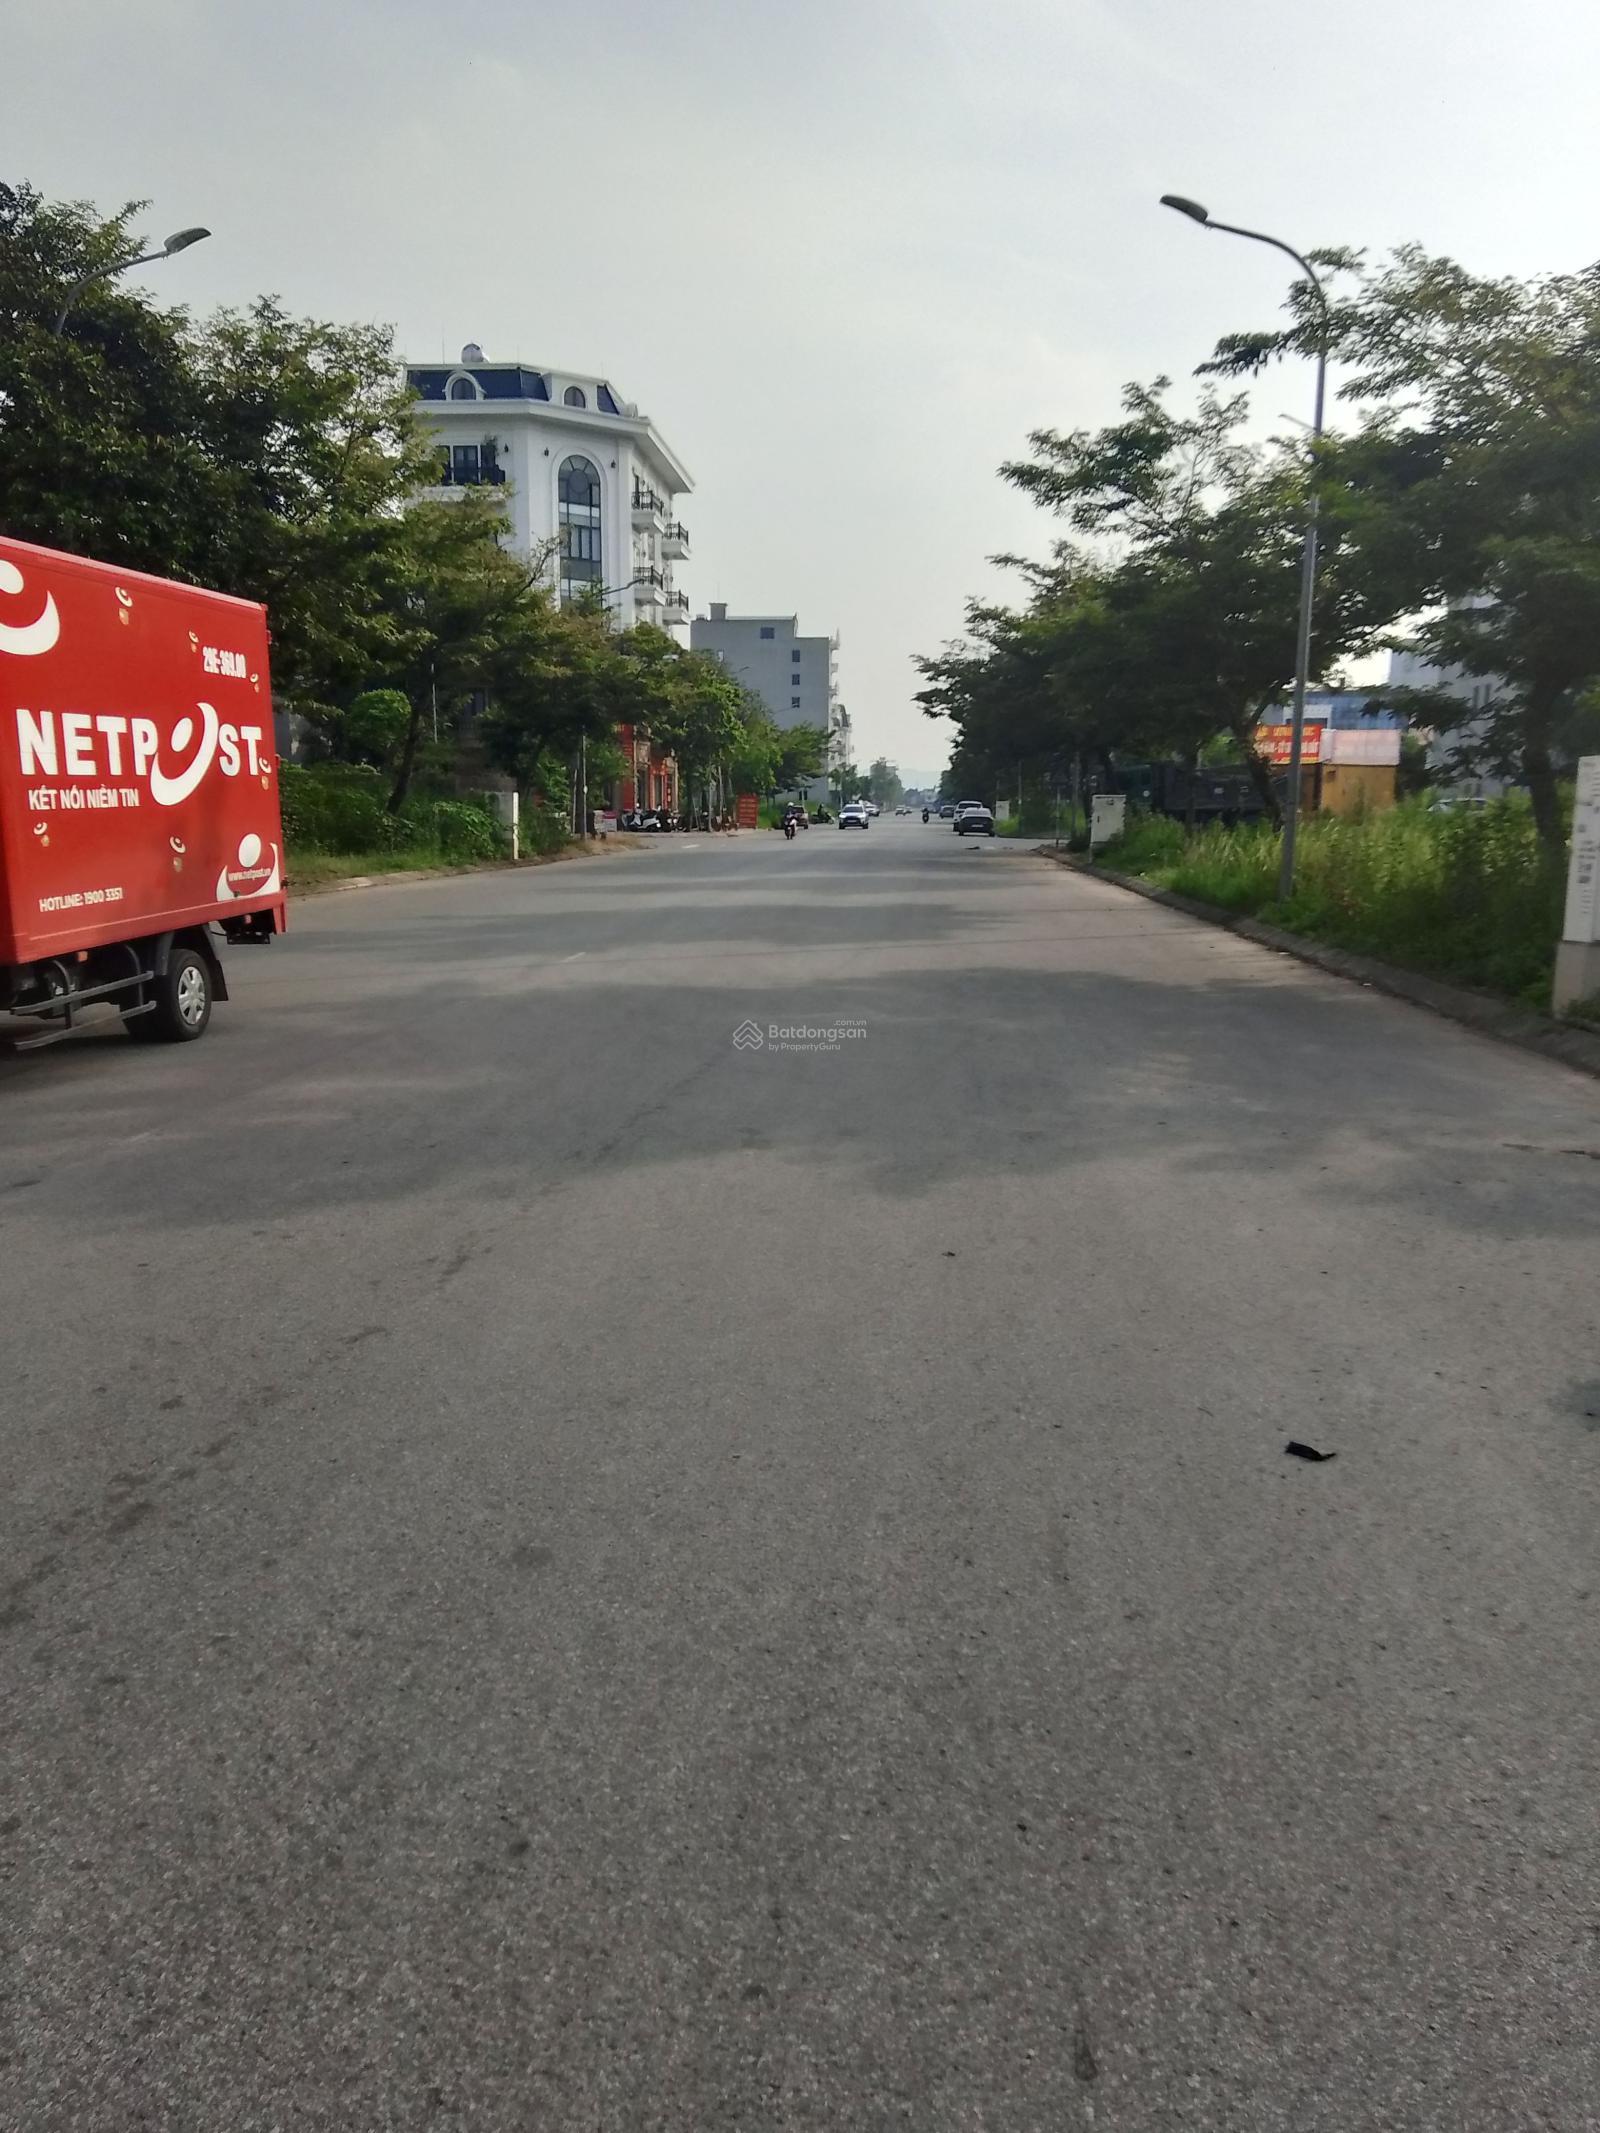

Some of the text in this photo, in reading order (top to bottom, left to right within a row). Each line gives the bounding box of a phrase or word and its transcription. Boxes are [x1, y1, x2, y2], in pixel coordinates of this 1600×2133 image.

[119, 788, 140, 807] TIN
[84, 890, 105, 905] 1900
[105, 887, 123, 902] 3351
